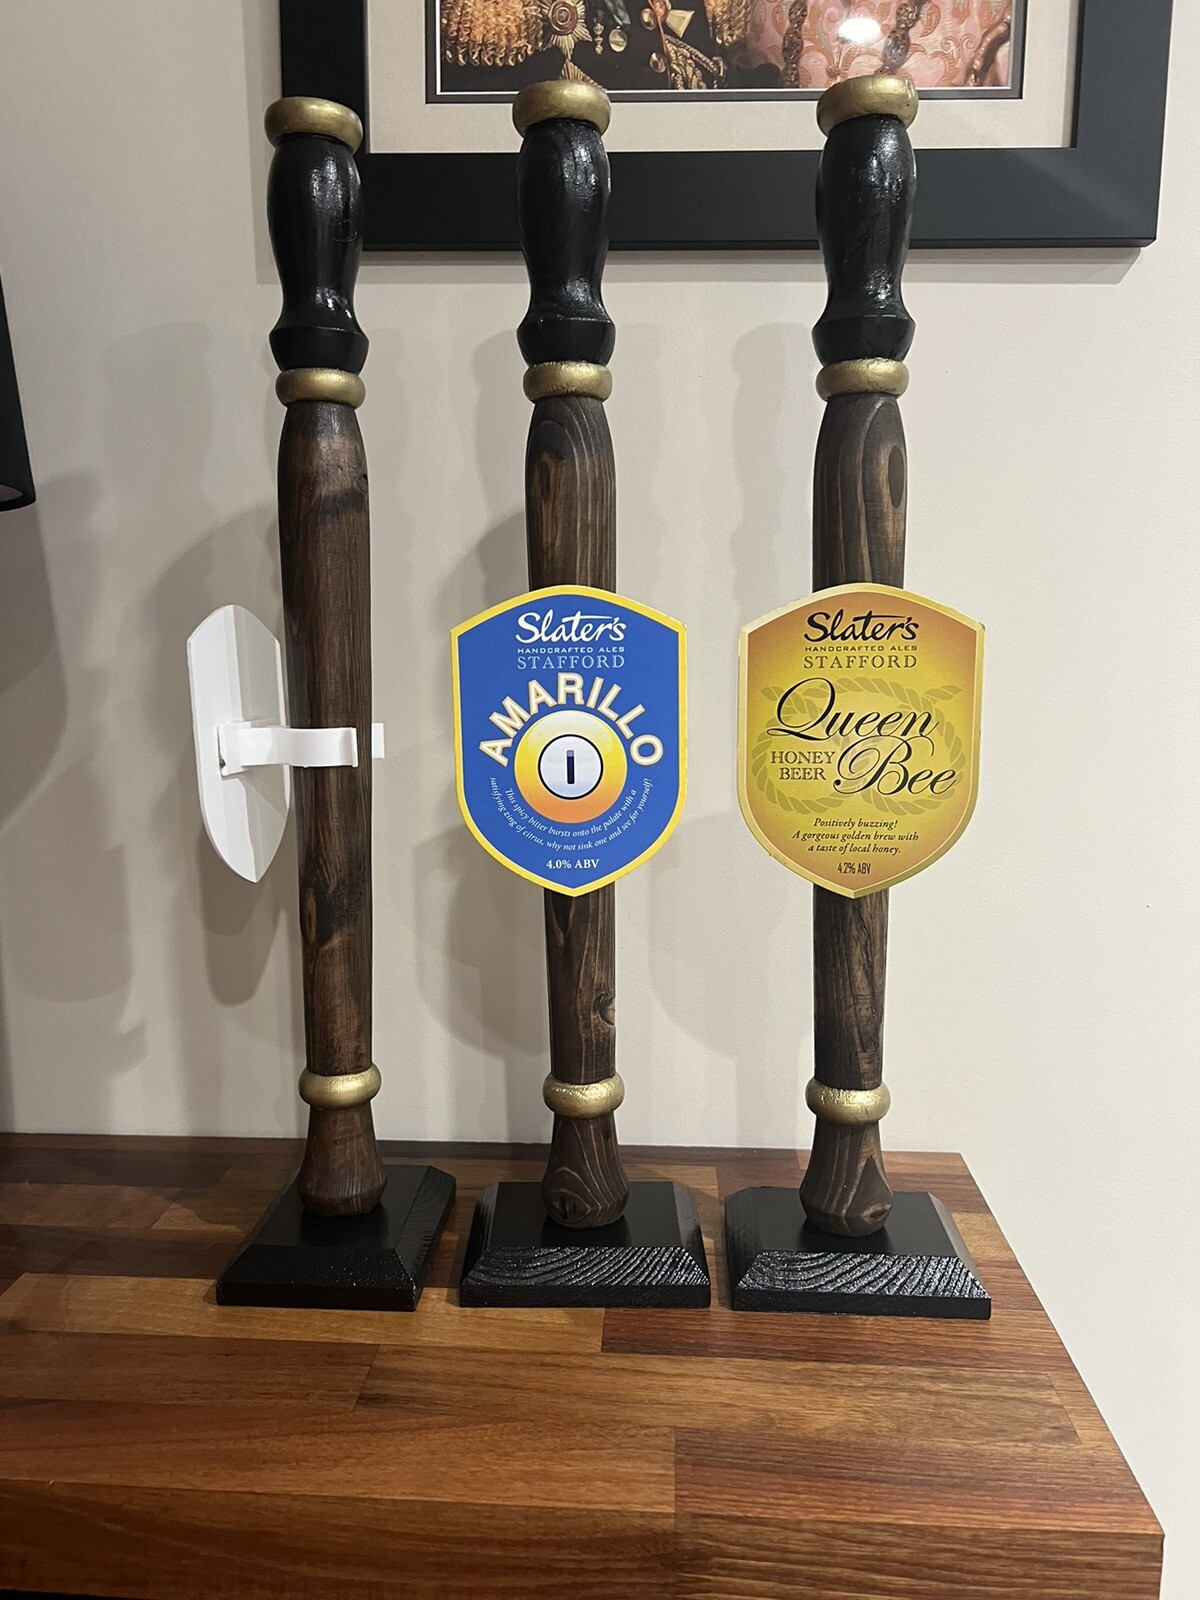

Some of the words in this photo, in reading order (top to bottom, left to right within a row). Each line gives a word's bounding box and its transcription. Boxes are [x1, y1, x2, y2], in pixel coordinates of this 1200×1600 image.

[515, 609, 627, 644] Slater's
[804, 609, 919, 642] Slater's
[517, 655, 625, 669] STAFFORD
[804, 655, 917, 669] STAFFORD
[767, 677, 939, 741] Queen
[478, 672, 664, 767] AMARILLO
[770, 750, 836, 764] HONEY
[833, 735, 956, 795] Bee
[779, 767, 826, 780] BEER
[490, 776, 506, 812] satisfying
[504, 812, 517, 827] zing
[516, 824, 526, 832] of
[523, 830, 544, 846] citrus,
[546, 841, 562, 852] why
[578, 841, 593, 850] sink
[594, 838, 607, 846] one
[608, 826, 622, 840] and
[622, 820, 632, 830] see
[630, 810, 639, 824] for
[637, 778, 653, 812] yourself!
[505, 788, 516, 804] This
[513, 801, 530, 820] spicy
[528, 817, 548, 831] bitter
[548, 826, 571, 838] bursts
[572, 829, 590, 837] onto
[591, 824, 602, 834] the
[603, 810, 622, 830] palate
[621, 796, 635, 812] with
[813, 818, 856, 830] Positively
[858, 818, 898, 830] buzzing!
[792, 830, 800, 838] A
[801, 832, 840, 842] gorgeous
[840, 831, 870, 842] golden
[874, 831, 896, 840] brew
[898, 832, 919, 840] with
[838, 843, 850, 854] of
[850, 844, 870, 852] local
[872, 844, 900, 856] honey.
[546, 859, 572, 869] 4.0%
[574, 859, 600, 868] ABV
[838, 862, 856, 874] 4.2%
[857, 862, 871, 874] ABV
